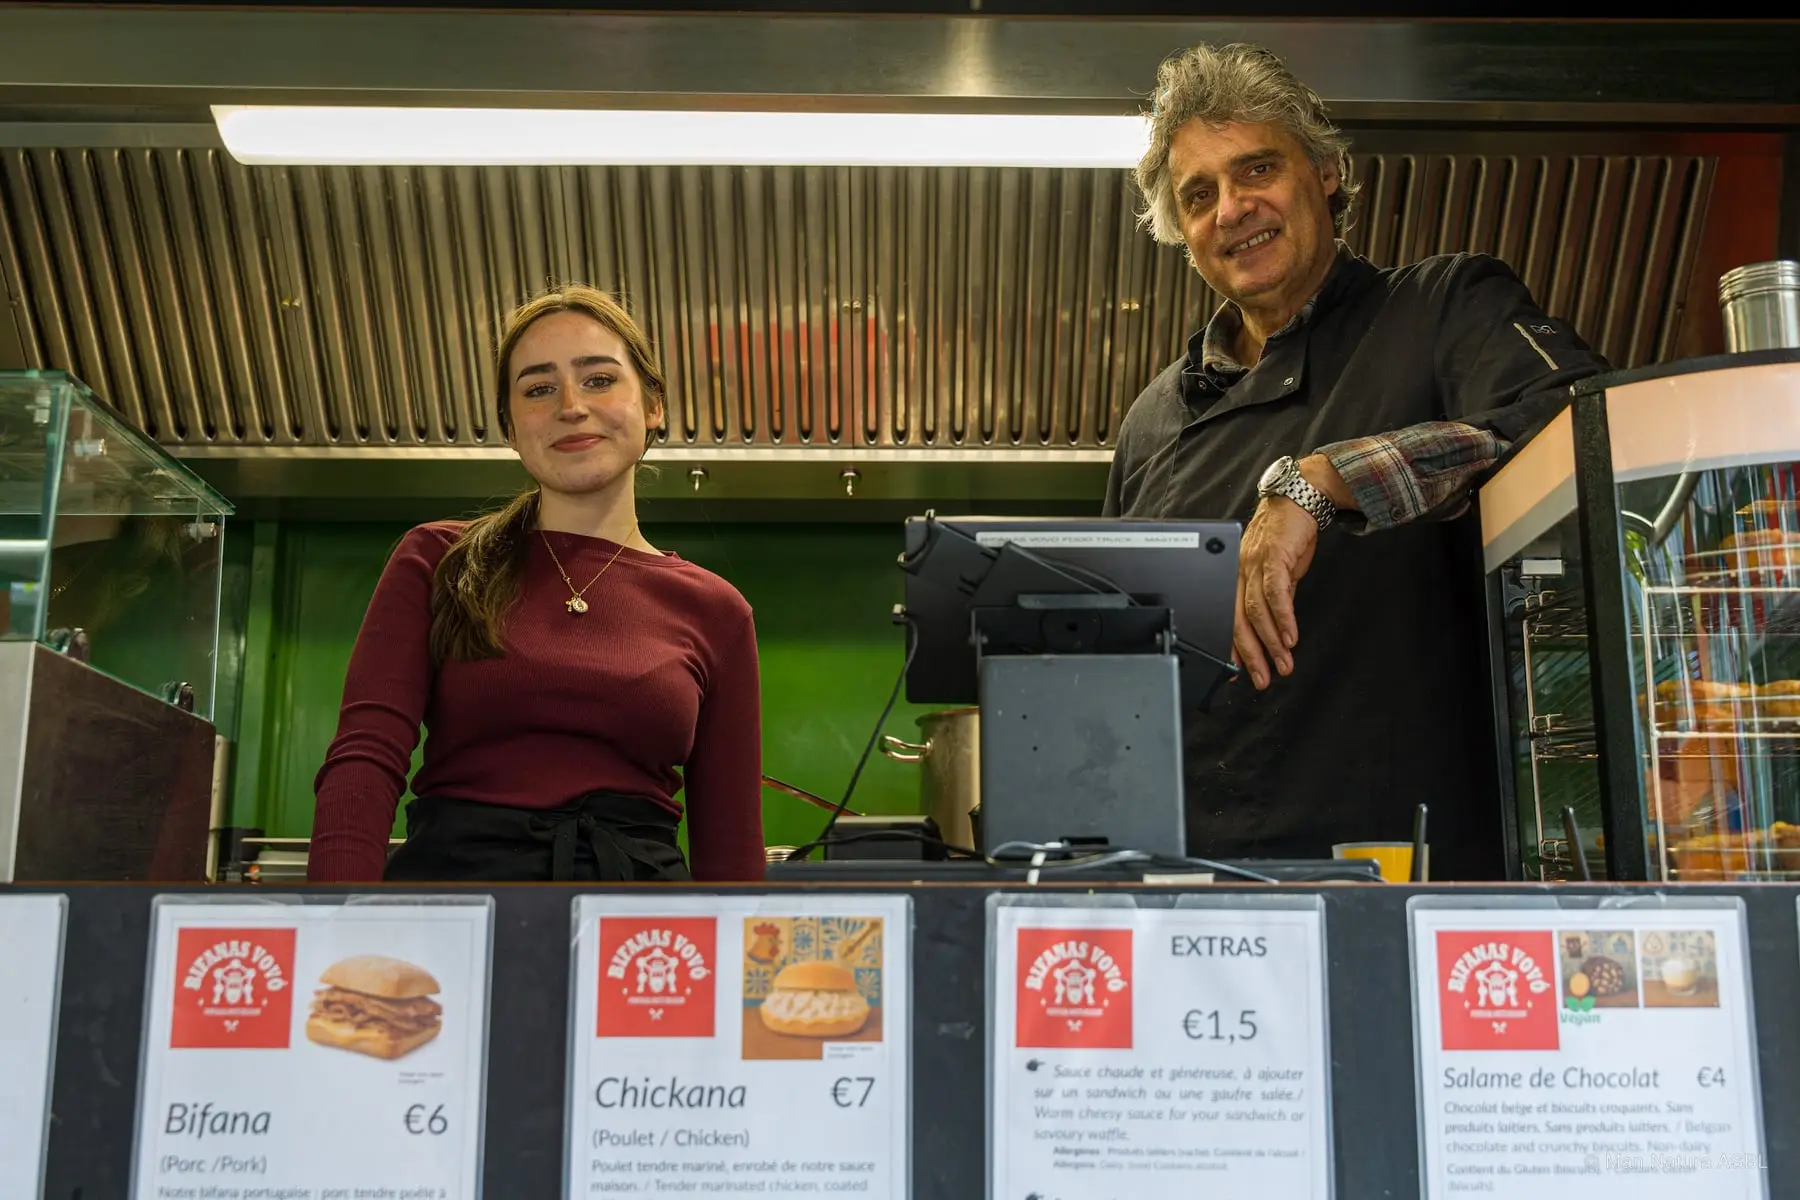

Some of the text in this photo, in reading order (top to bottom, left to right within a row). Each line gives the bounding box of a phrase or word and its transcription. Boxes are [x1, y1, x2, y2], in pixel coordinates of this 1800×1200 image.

[607, 929, 672, 979] BIFANAS
[1171, 936, 1267, 958] EXTRAS
[183, 940, 251, 991] BIFANAS
[1025, 940, 1089, 991] BIFANAS
[1447, 942, 1509, 993] BIFANAS
[1182, 1009, 1258, 1044] €1,5
[1560, 1012, 1600, 1025] Vegan
[1054, 1064, 1090, 1078] Sauce
[1097, 1066, 1144, 1078] chaude
[1150, 1067, 1163, 1078] et
[1243, 1066, 1252, 1080] à
[1257, 1066, 1303, 1082] ajouter
[1443, 1066, 1726, 1088] Salame de Chocolat €4
[595, 1076, 875, 1109] Chickana €7
[1034, 1087, 1053, 1098] sur
[1062, 1088, 1078, 1098] un
[1086, 1086, 1147, 1099] sandwich
[1155, 1088, 1171, 1099] ou
[1180, 1089, 1203, 1099] une
[1211, 1087, 1253, 1102] gaufre
[1034, 1106, 1305, 1122] Warm cheesy sauce for your sandwich or
[1444, 1101, 1497, 1114] Chocolat
[1501, 1101, 1533, 1115] belge
[1536, 1102, 1548, 1113] et
[1551, 1101, 1596, 1113] biscuits
[1666, 1101, 1694, 1113] Sans
[164, 1102, 448, 1139] Bifana €6
[1445, 1121, 1494, 1135] produits
[1544, 1121, 1572, 1133] Sans
[1575, 1121, 1624, 1135] produits
[1685, 1121, 1731, 1135] Belgian
[592, 1129, 654, 1148] (Poulet
[674, 1129, 750, 1148] Chicken)
[1034, 1129, 1083, 1142] savoury
[1446, 1141, 1508, 1153] chocolate
[1511, 1141, 1535, 1153] and
[1538, 1141, 1588, 1155] crunchy
[160, 1155, 205, 1174] (Porc
[592, 1160, 632, 1172] Poulet
[637, 1160, 678, 1172] tendre
[733, 1160, 777, 1172] enrobé
[782, 1160, 796, 1172] de
[801, 1162, 834, 1172] notre
[839, 1163, 875, 1172] sauce
[159, 1186, 197, 1198] Notre
[200, 1185, 239, 1198] bifana
[354, 1186, 395, 1198] tendre
[655, 1180, 698, 1191] Tender
[702, 1179, 765, 1191] marinated
[824, 1179, 868, 1191] coated
